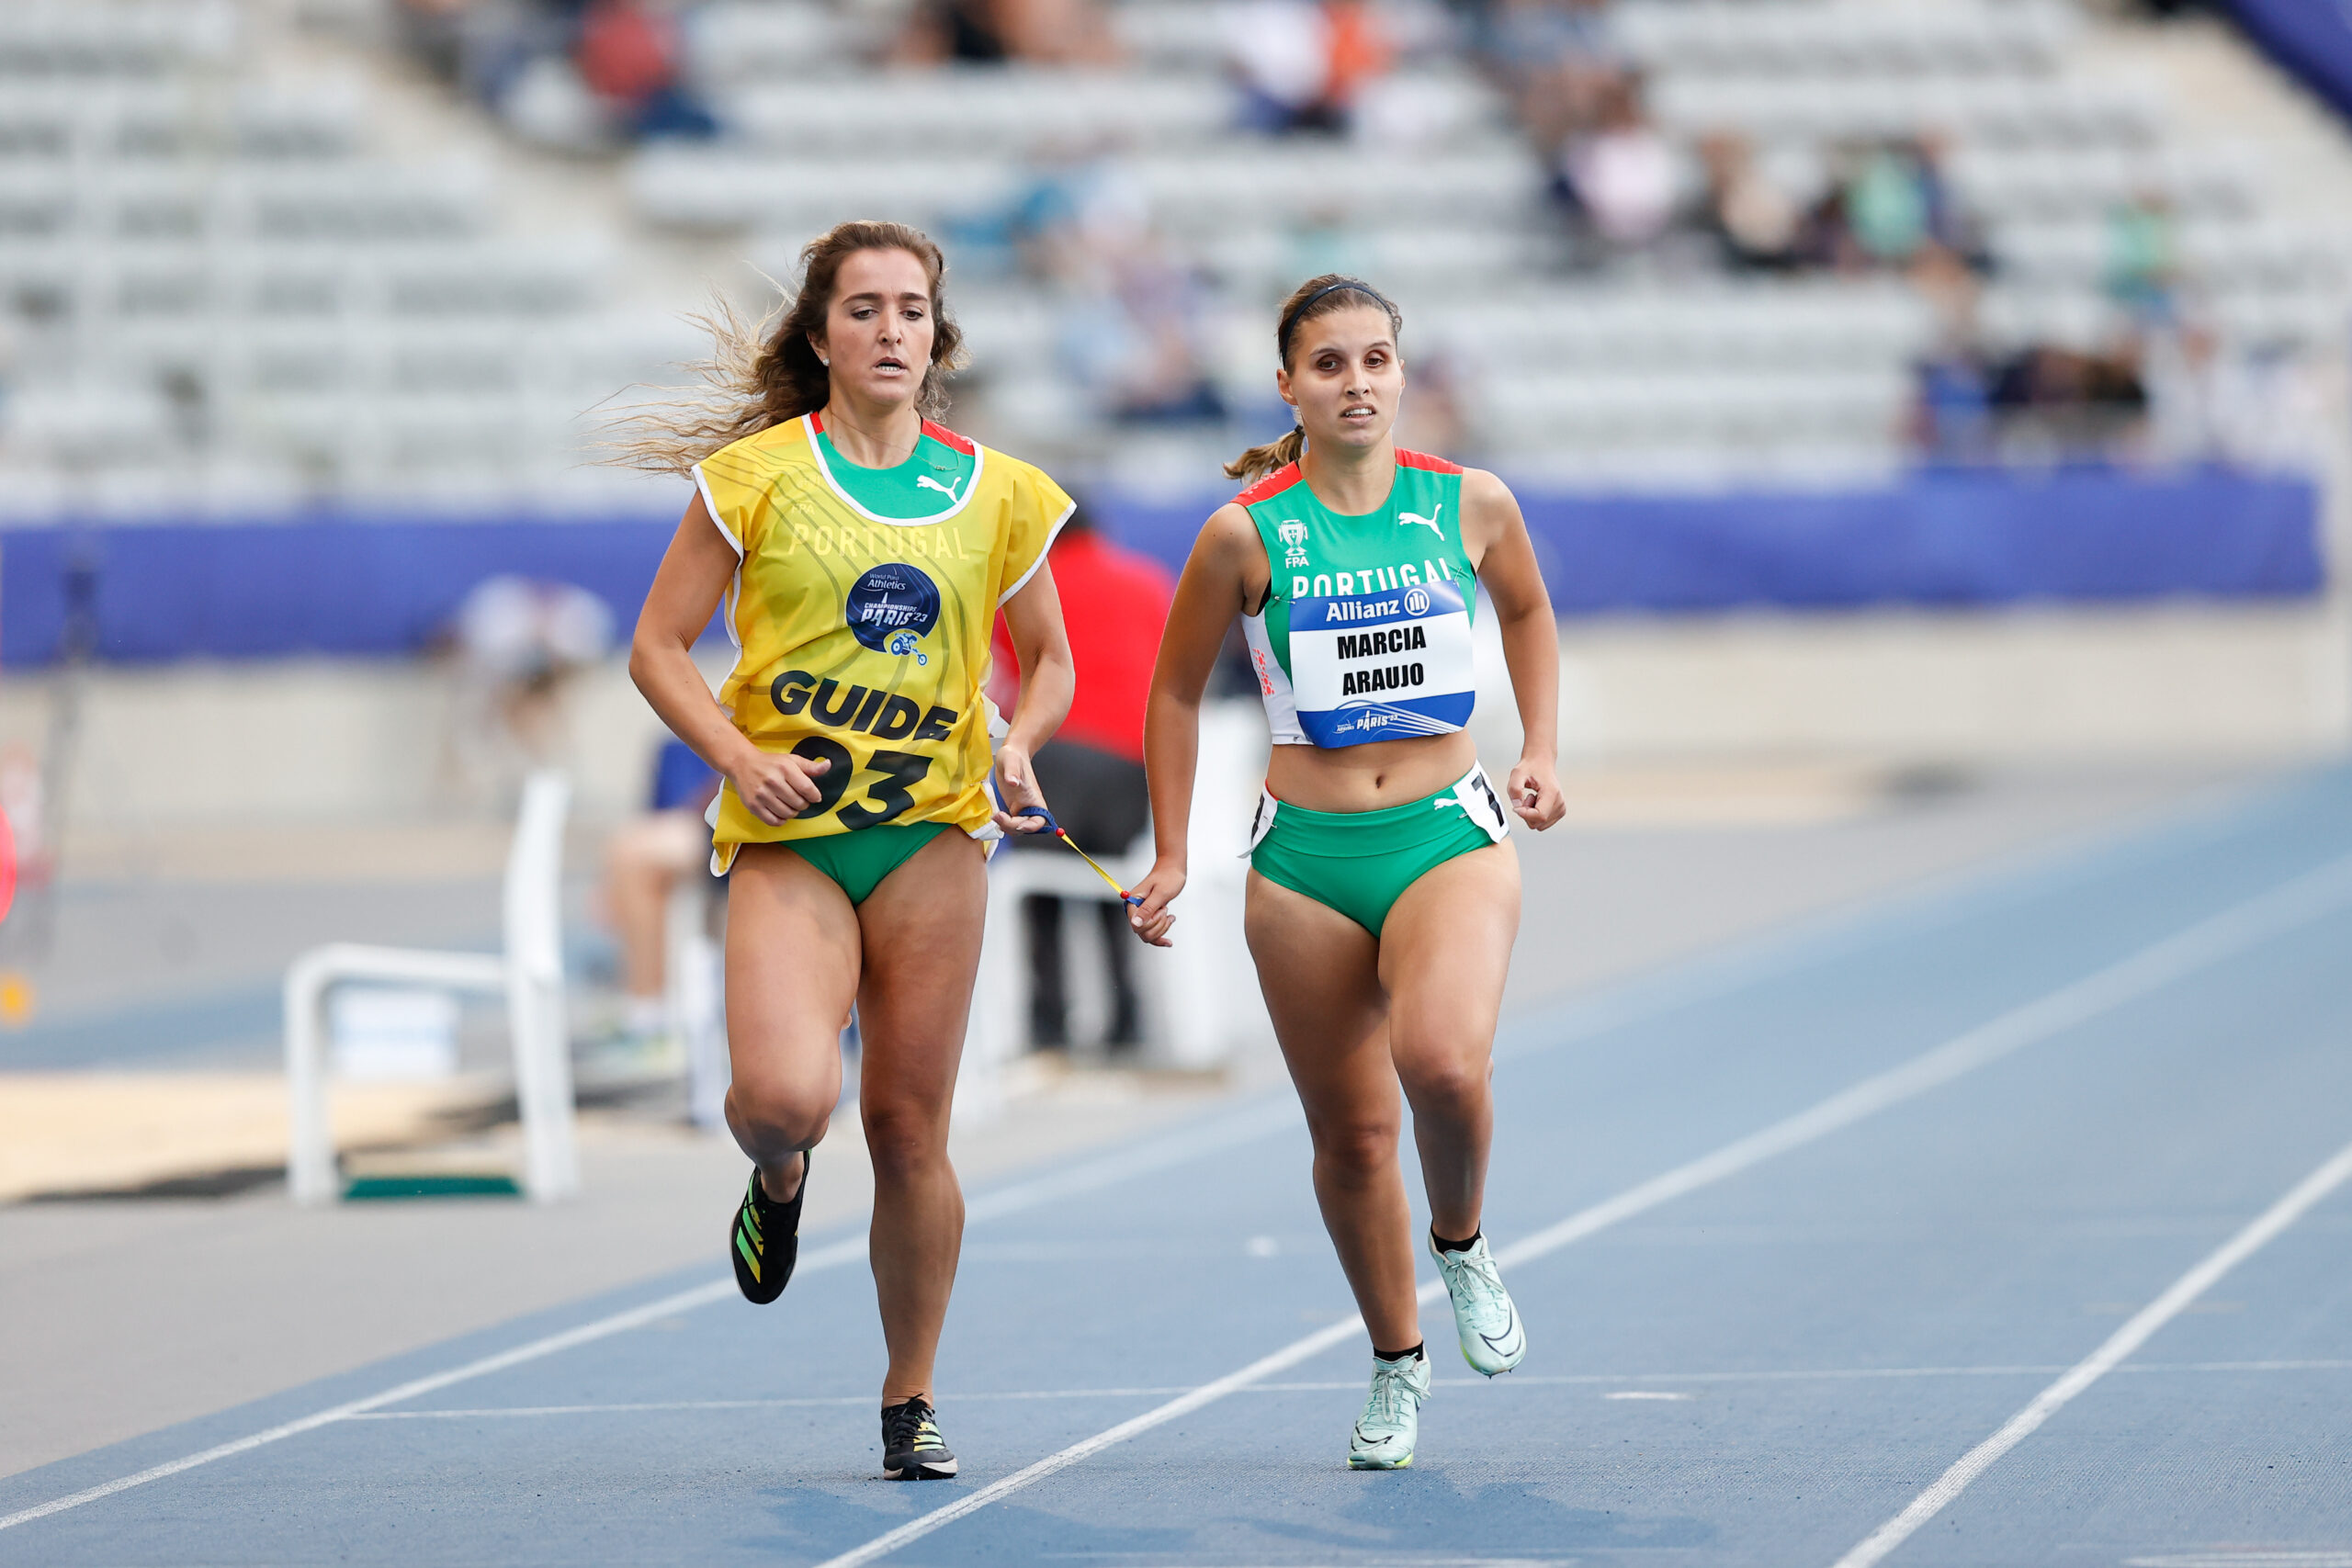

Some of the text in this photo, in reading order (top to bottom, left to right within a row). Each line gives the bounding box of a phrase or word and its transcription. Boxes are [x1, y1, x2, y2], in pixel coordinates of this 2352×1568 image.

[788, 523, 970, 560] PORTUGAL
[1285, 556, 1310, 569] FPA
[867, 579, 906, 590] Athletics
[864, 603, 917, 612] CHAMPIONSHIPS
[1326, 599, 1400, 622] Allianz
[1337, 626, 1427, 660] MARCIA
[1342, 662, 1424, 696] ARAUJO
[770, 670, 958, 741] GUIDE
